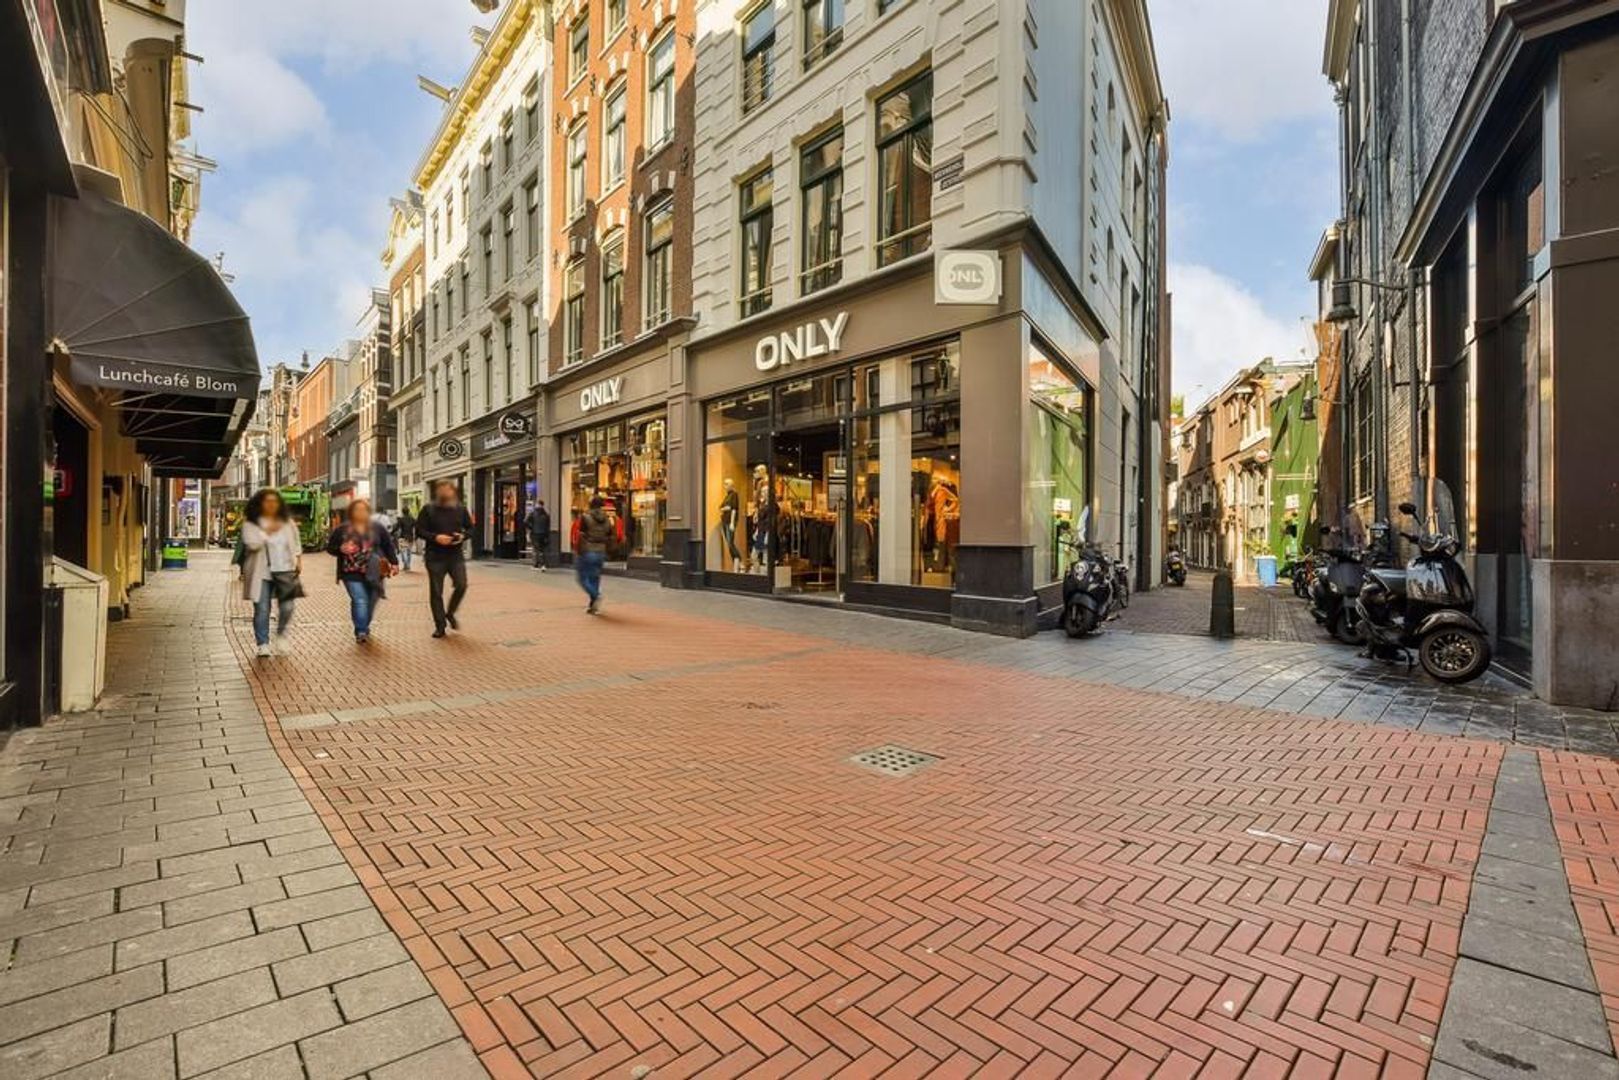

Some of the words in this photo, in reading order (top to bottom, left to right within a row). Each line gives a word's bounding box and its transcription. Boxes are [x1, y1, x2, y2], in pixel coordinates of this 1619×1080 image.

[755, 311, 849, 370] ONLY
[99, 365, 190, 388] Lunchcafé
[195, 376, 237, 392] Blom
[580, 377, 623, 411] ONLY
